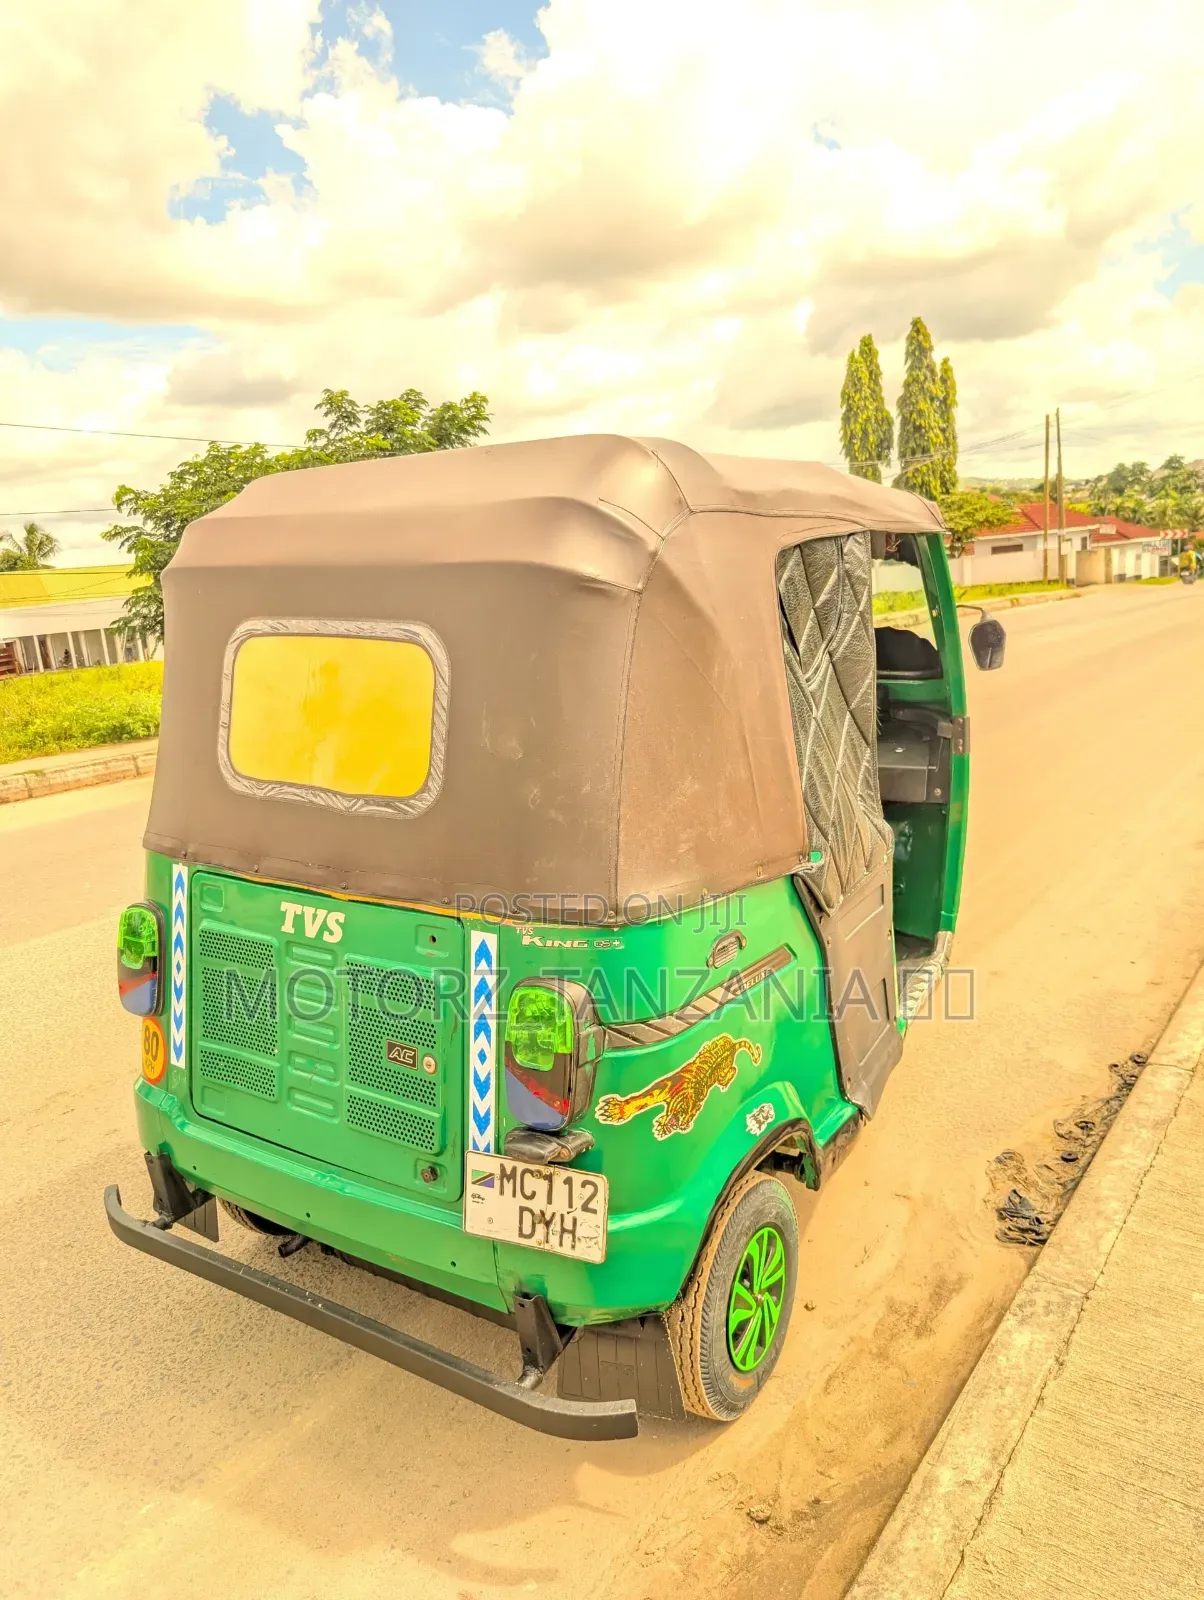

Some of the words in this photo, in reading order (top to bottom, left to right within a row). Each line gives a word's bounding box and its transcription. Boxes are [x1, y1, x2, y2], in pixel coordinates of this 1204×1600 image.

[280, 901, 346, 943] TVS
[516, 927, 534, 935] TVS
[521, 935, 589, 949] KING
[740, 967, 773, 993] DELUXE
[143, 1024, 160, 1062] 80
[388, 1046, 415, 1064] AC
[518, 1205, 578, 1251] DYH
